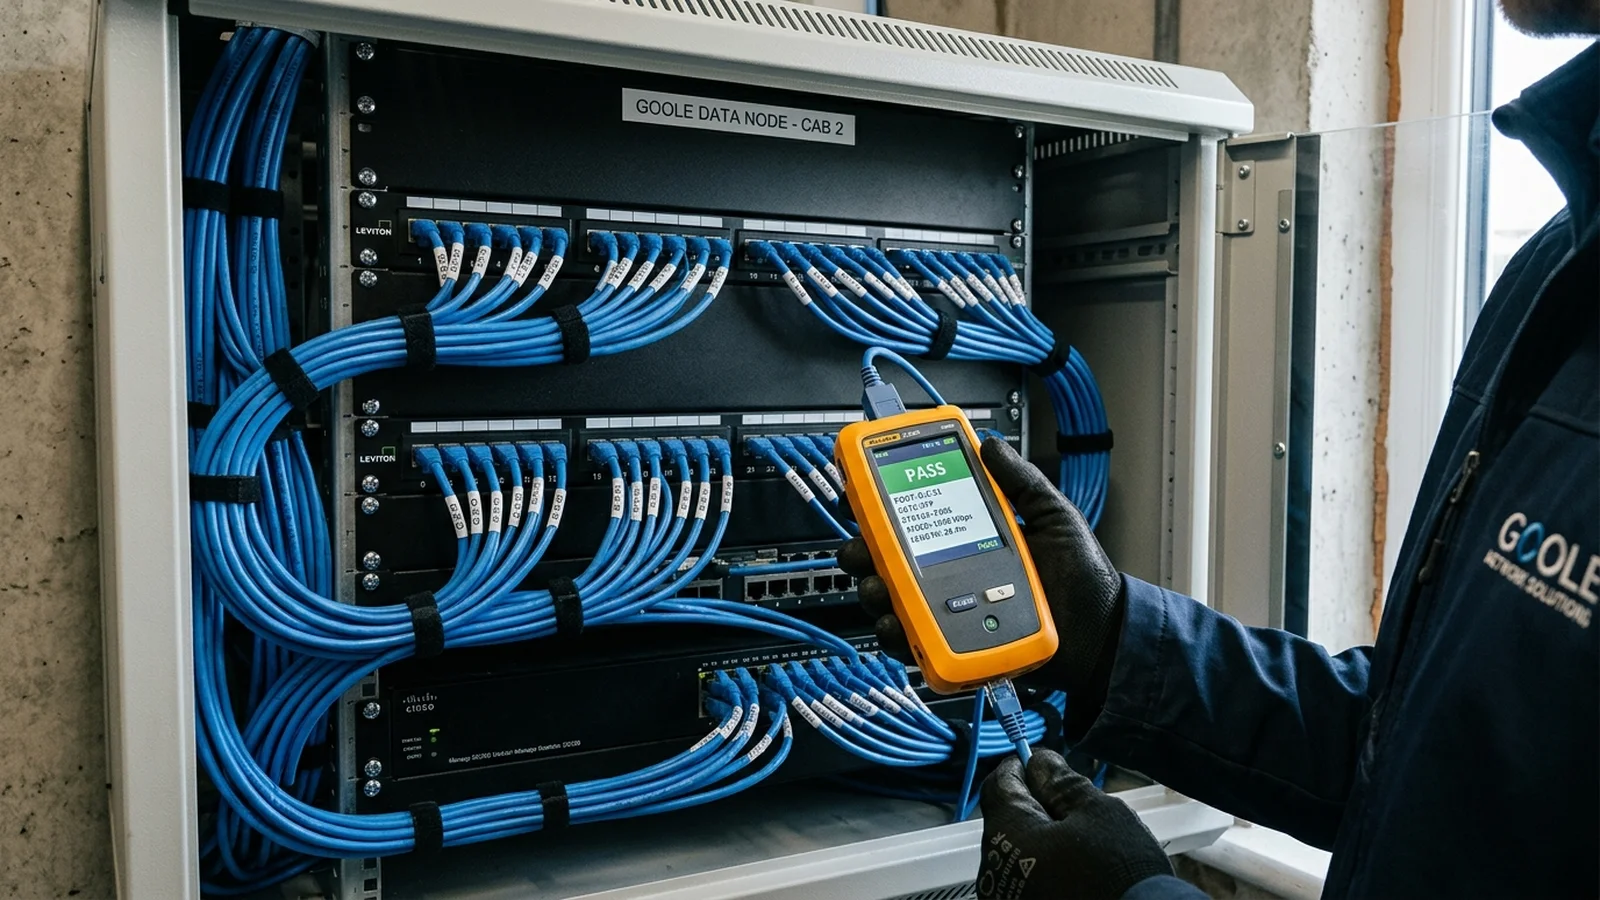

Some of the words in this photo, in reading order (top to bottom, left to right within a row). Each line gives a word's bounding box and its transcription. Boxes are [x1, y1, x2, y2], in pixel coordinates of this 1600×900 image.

[636, 98, 694, 119] GOOLE
[699, 105, 741, 124] DATA
[744, 111, 788, 129] NODE
[801, 117, 831, 134] CAB
[835, 122, 844, 136] 2
[355, 226, 392, 236] LEVITON
[359, 454, 396, 463] LEVITON
[905, 461, 947, 483] PASS
[1497, 511, 1600, 605] GOOLE
